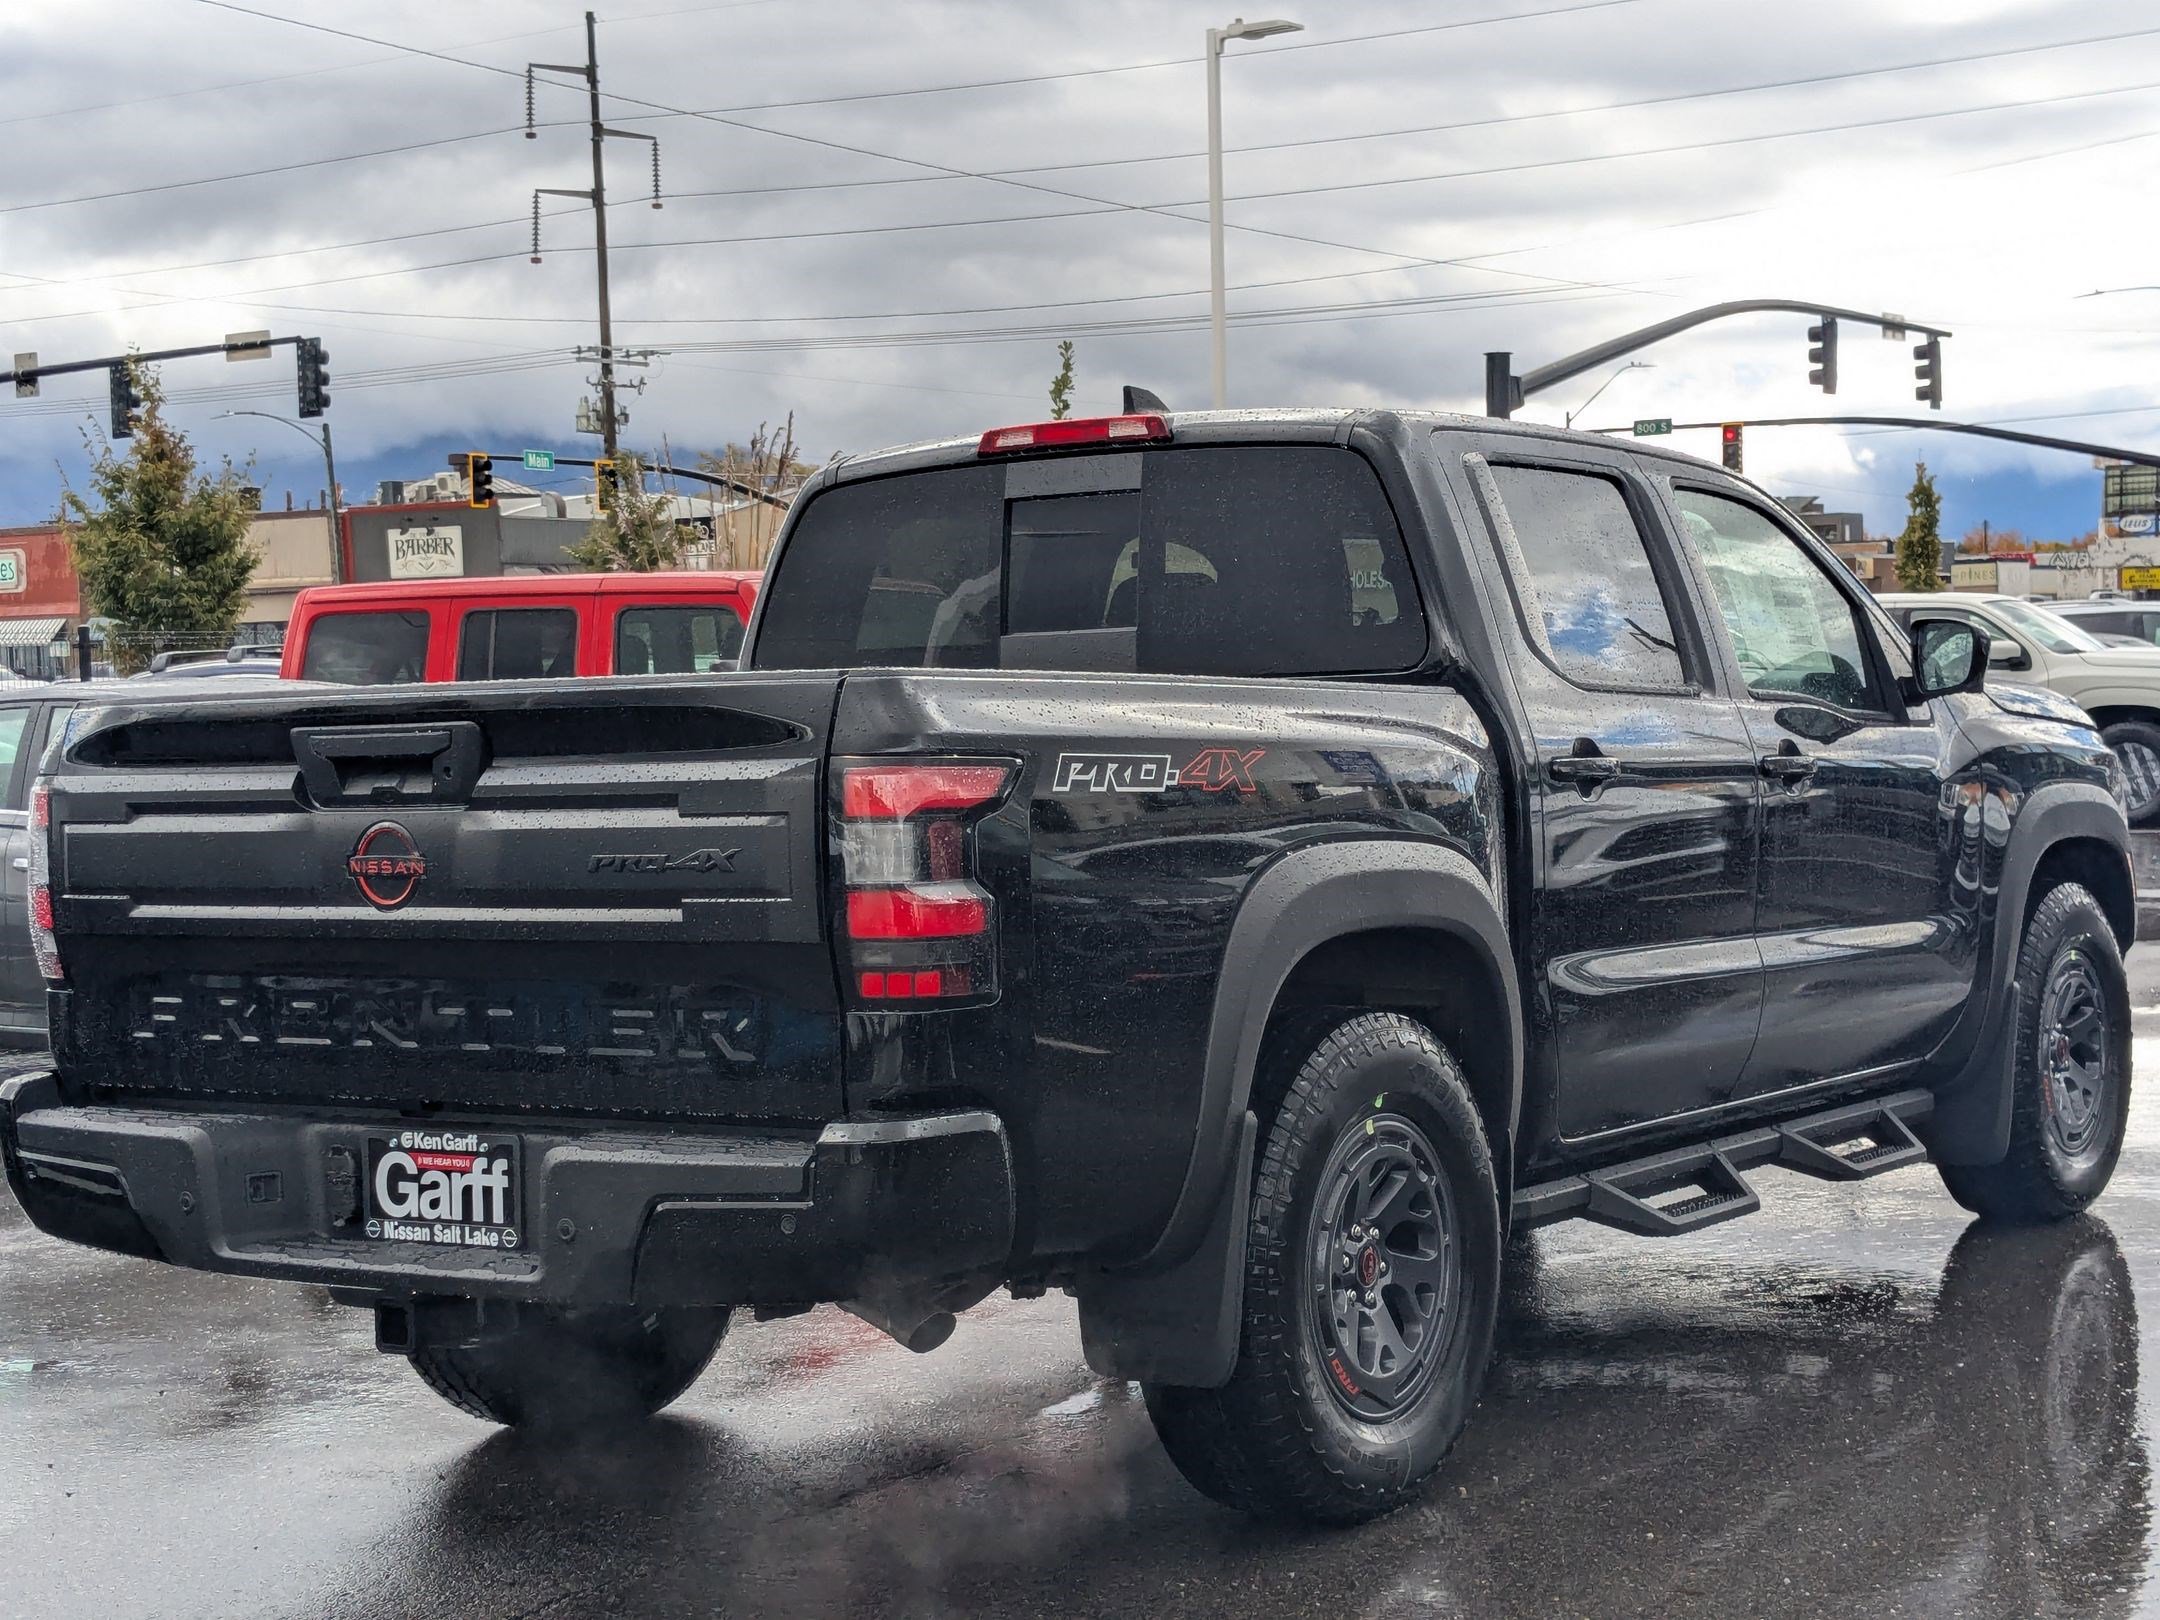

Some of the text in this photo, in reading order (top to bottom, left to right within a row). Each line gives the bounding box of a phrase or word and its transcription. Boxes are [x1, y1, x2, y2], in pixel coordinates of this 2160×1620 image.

[1660, 422, 1668, 432] S
[528, 452, 550, 468] Main
[395, 537, 456, 561] BARBER
[350, 859, 426, 875] NISSAN
[414, 1132, 478, 1151] Ken Garff
[423, 1157, 466, 1168] WE HEAR YOU
[375, 1151, 509, 1224] Garff
[383, 1221, 499, 1247] Nissan Salt Lake
